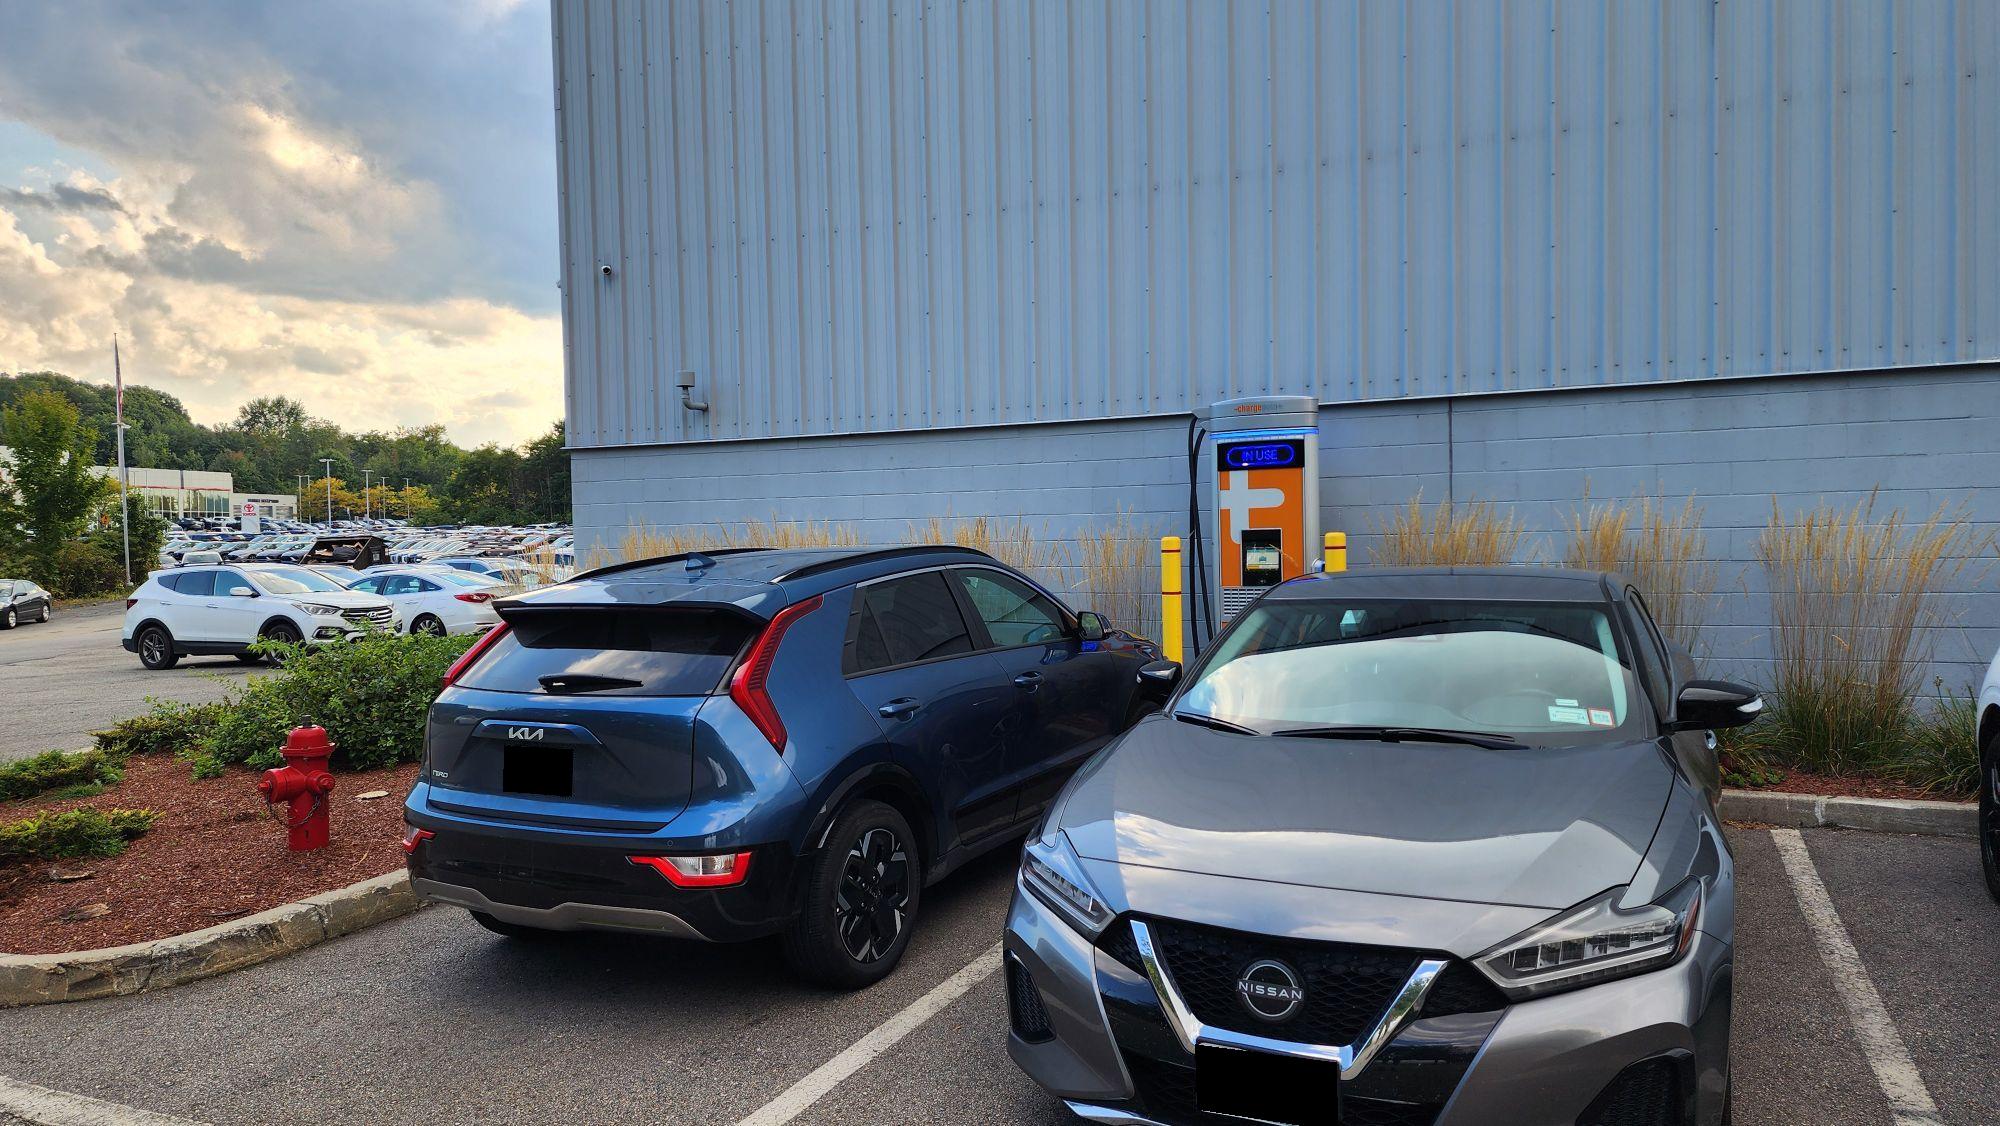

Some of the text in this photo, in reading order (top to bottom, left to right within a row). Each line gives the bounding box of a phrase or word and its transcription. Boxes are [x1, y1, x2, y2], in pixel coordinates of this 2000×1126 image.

[1242, 449, 1278, 461] IN USE
[508, 726, 544, 740] KIA
[432, 769, 449, 778] NIRO
[1238, 981, 1302, 1000] NISSAN
